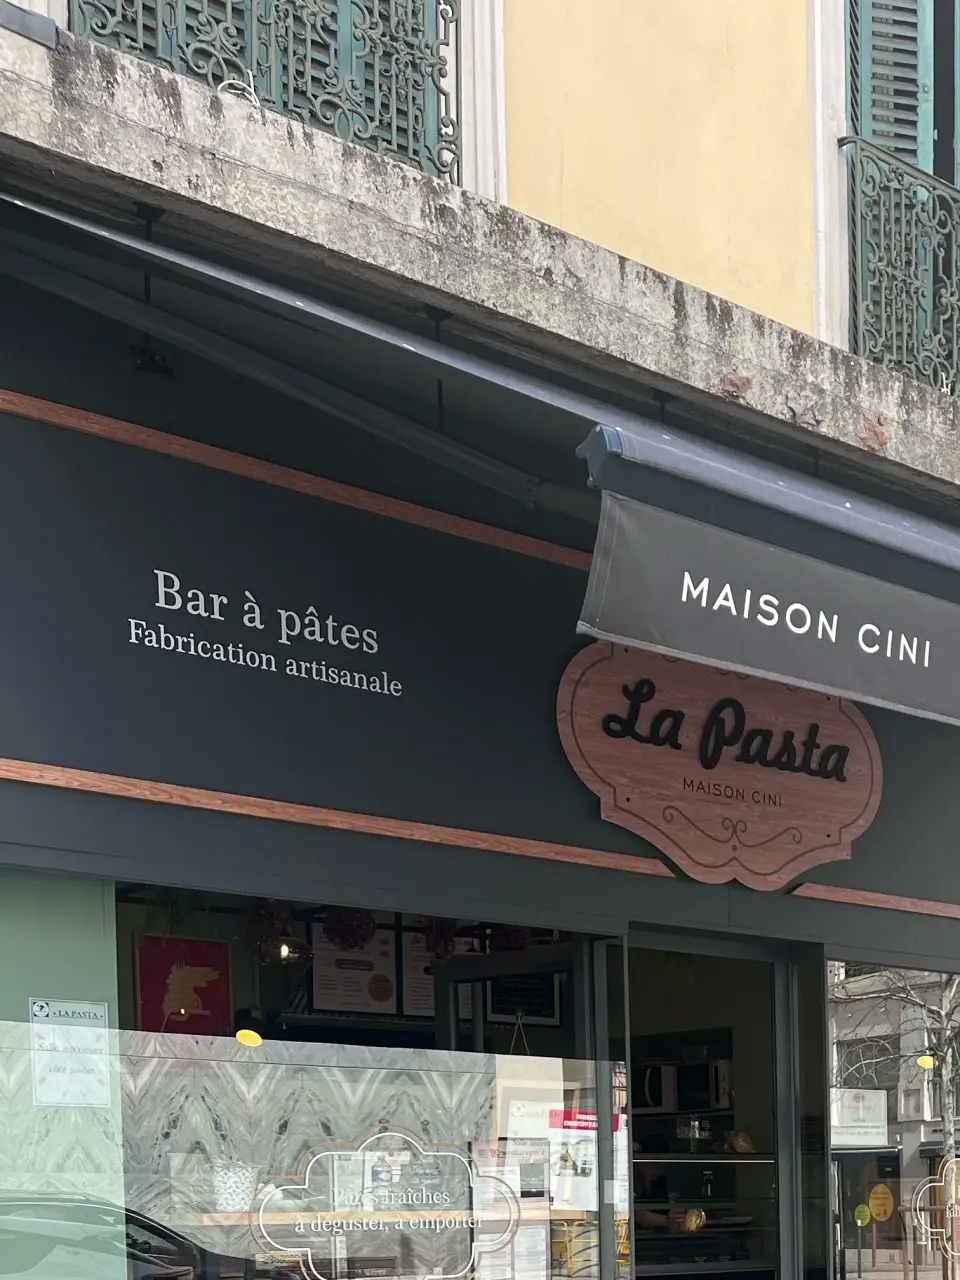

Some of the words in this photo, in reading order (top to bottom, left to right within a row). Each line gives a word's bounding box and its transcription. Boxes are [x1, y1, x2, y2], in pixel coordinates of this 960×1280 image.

[153, 569, 228, 621] Bar
[242, 590, 265, 630] à
[277, 600, 380, 654] pâtes
[681, 571, 838, 643] MAISON
[858, 623, 931, 667] CINI
[127, 618, 278, 673] Fabrication
[285, 656, 403, 697] artisanale
[602, 679, 685, 750] La
[699, 697, 850, 782] Pasta
[683, 777, 746, 801] MAISON
[751, 790, 783, 807] CINI
[410, 1216, 484, 1233] emporter
